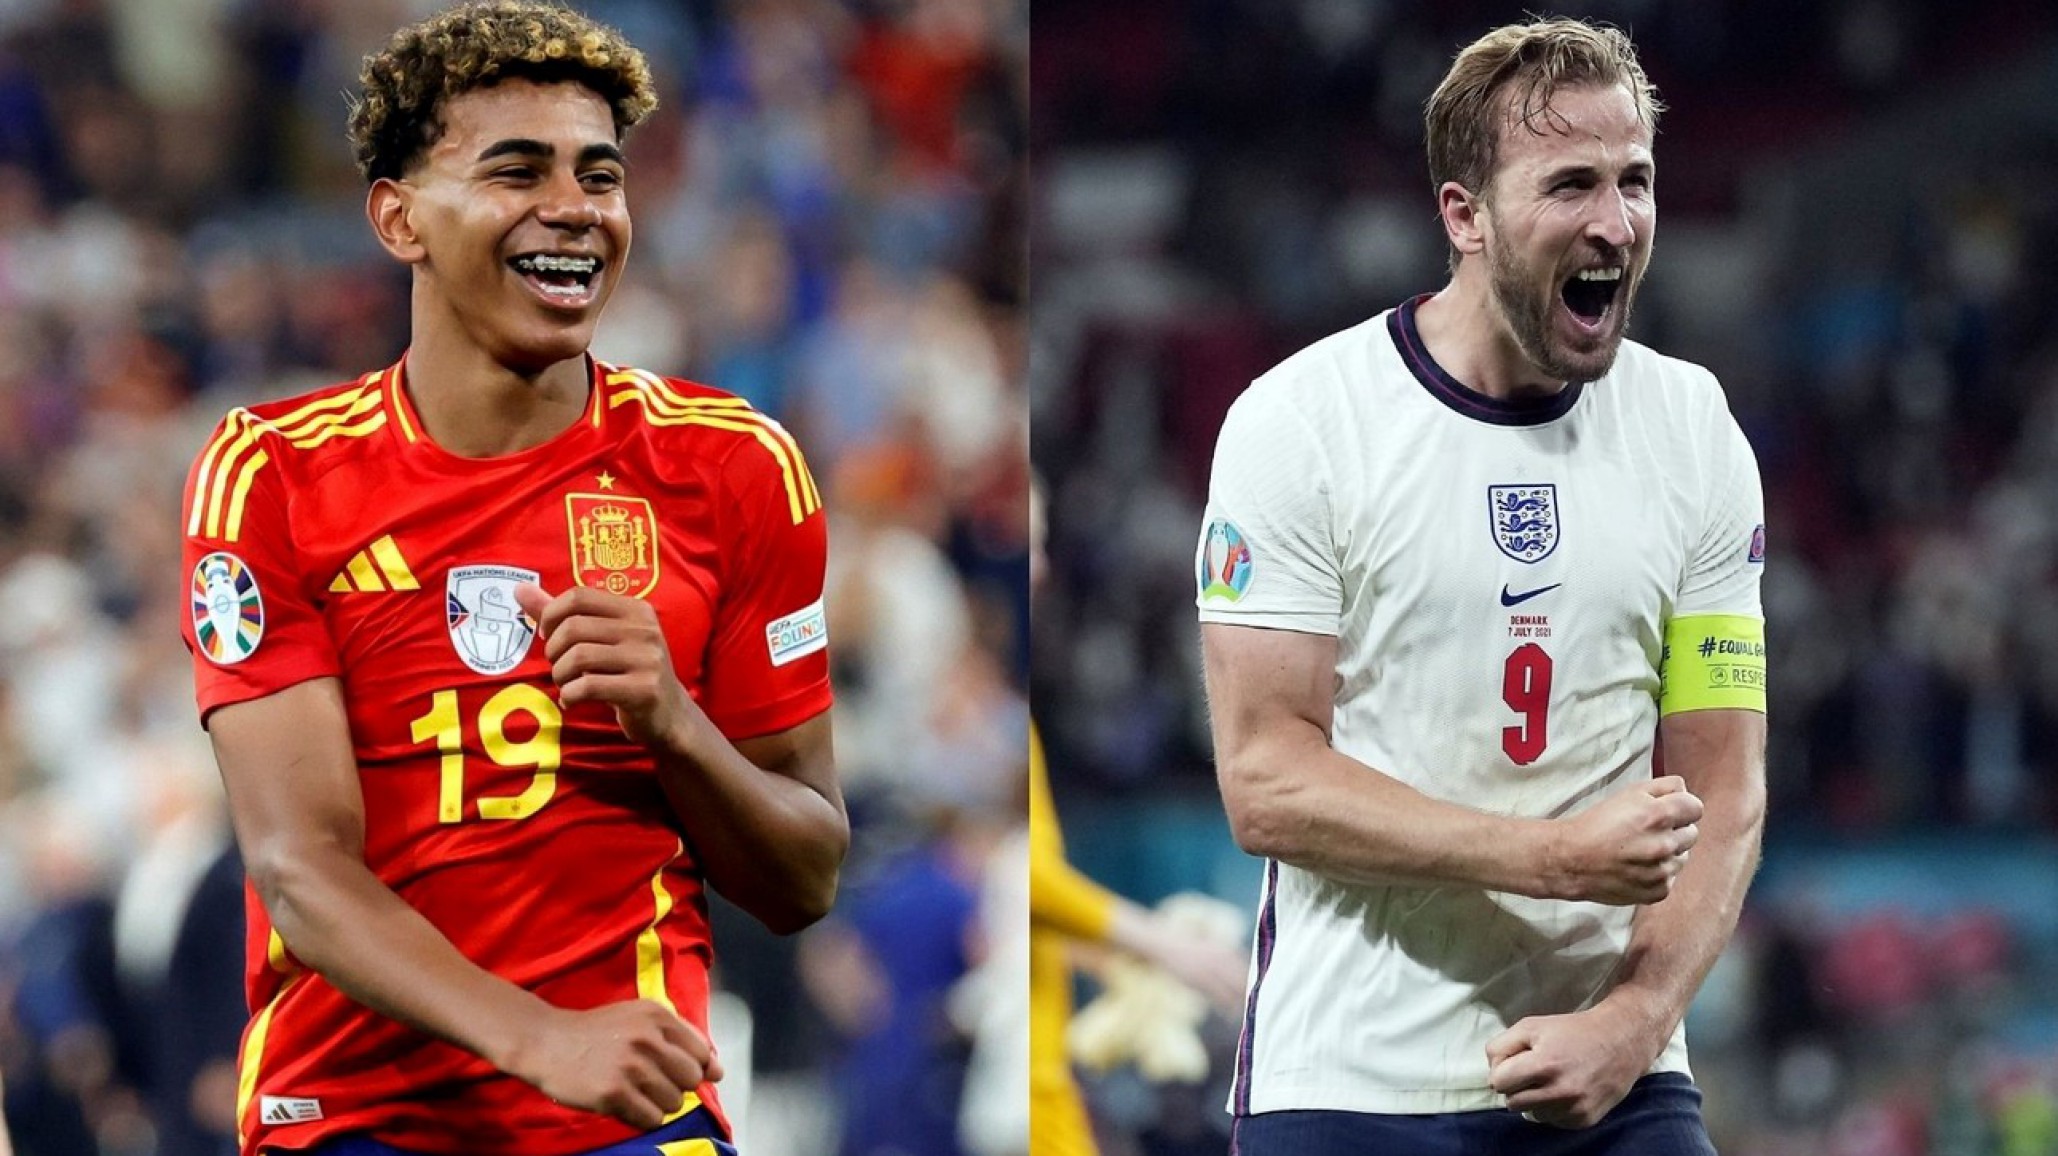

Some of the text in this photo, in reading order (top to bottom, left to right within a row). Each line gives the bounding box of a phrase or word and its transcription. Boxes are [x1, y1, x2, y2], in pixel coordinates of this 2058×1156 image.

[453, 570, 472, 578] UEFA
[1511, 615, 1548, 625] DENMARK
[1508, 627, 1551, 638] 7 JULY 2021
[1732, 668, 1766, 686] RESPE
[1502, 641, 1553, 766] 9
[410, 682, 563, 823] 19
